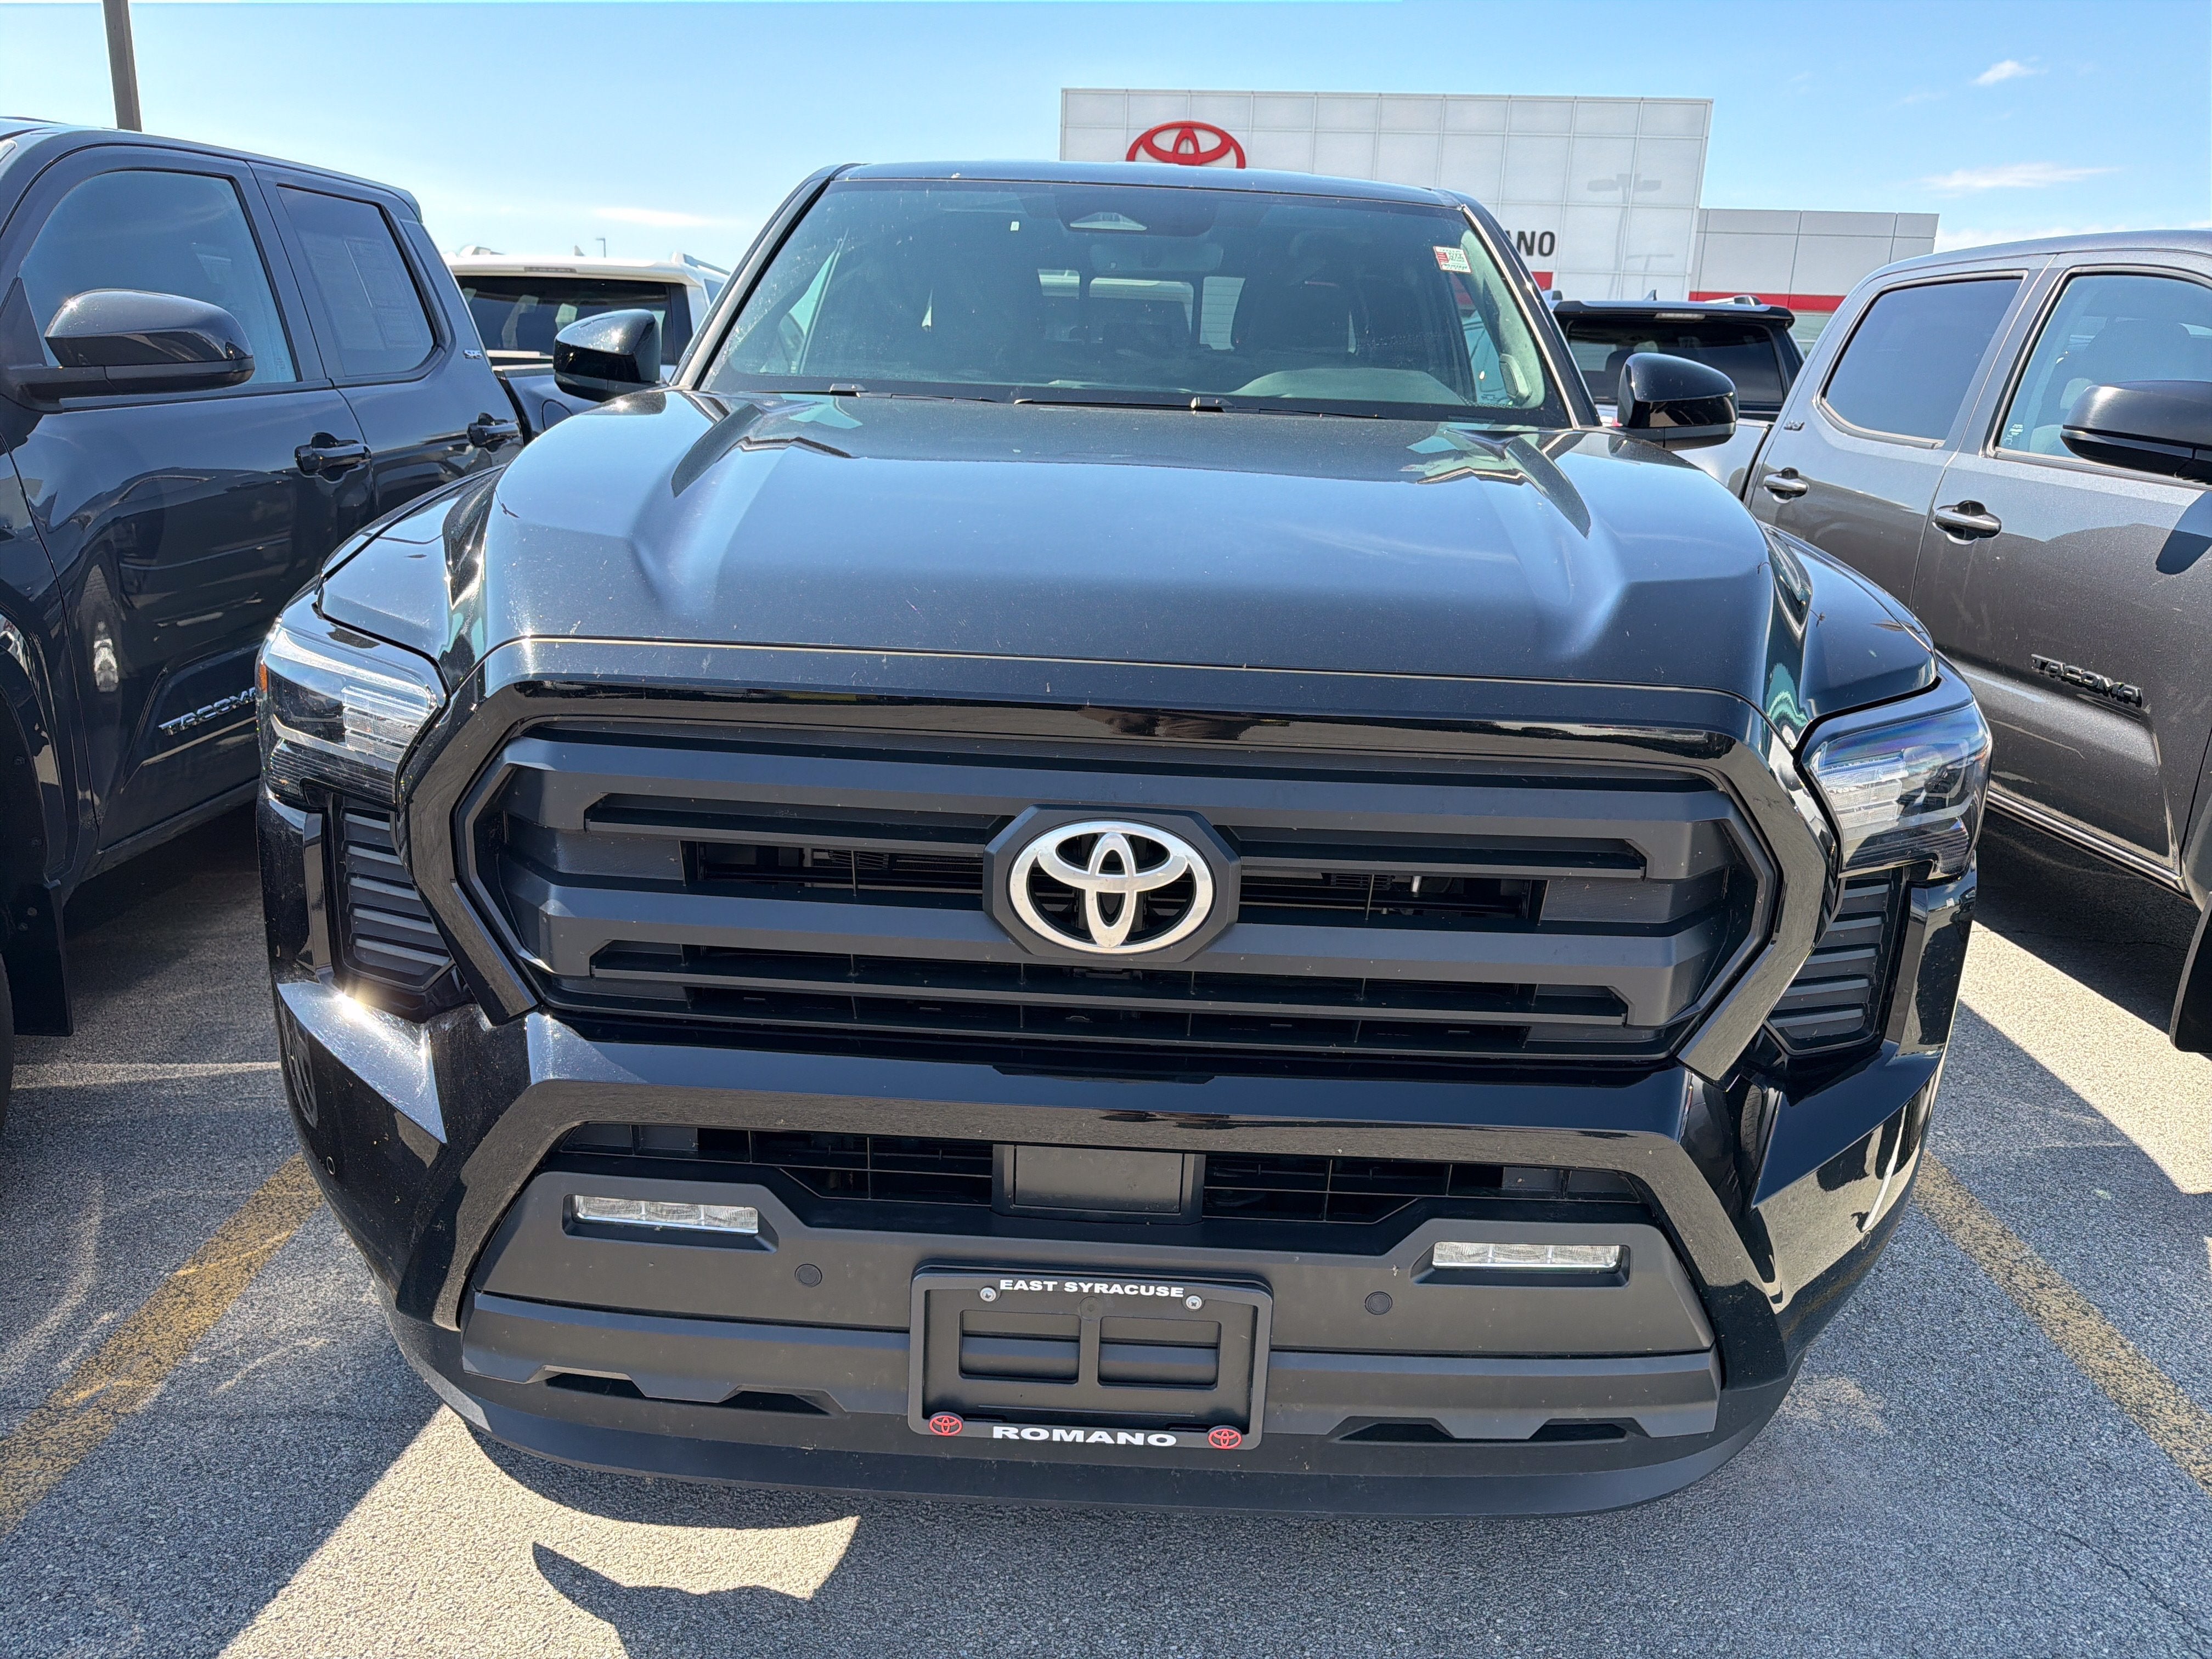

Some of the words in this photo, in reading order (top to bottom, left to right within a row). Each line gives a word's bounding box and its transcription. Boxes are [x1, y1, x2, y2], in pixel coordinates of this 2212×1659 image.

[1505, 230, 1555, 257] NO
[2031, 653, 2143, 708] TACOMA
[1000, 1279, 1058, 1291] EAST
[1064, 1282, 1184, 1297] SYRACUSE
[992, 1426, 1177, 1447] ROMANO
